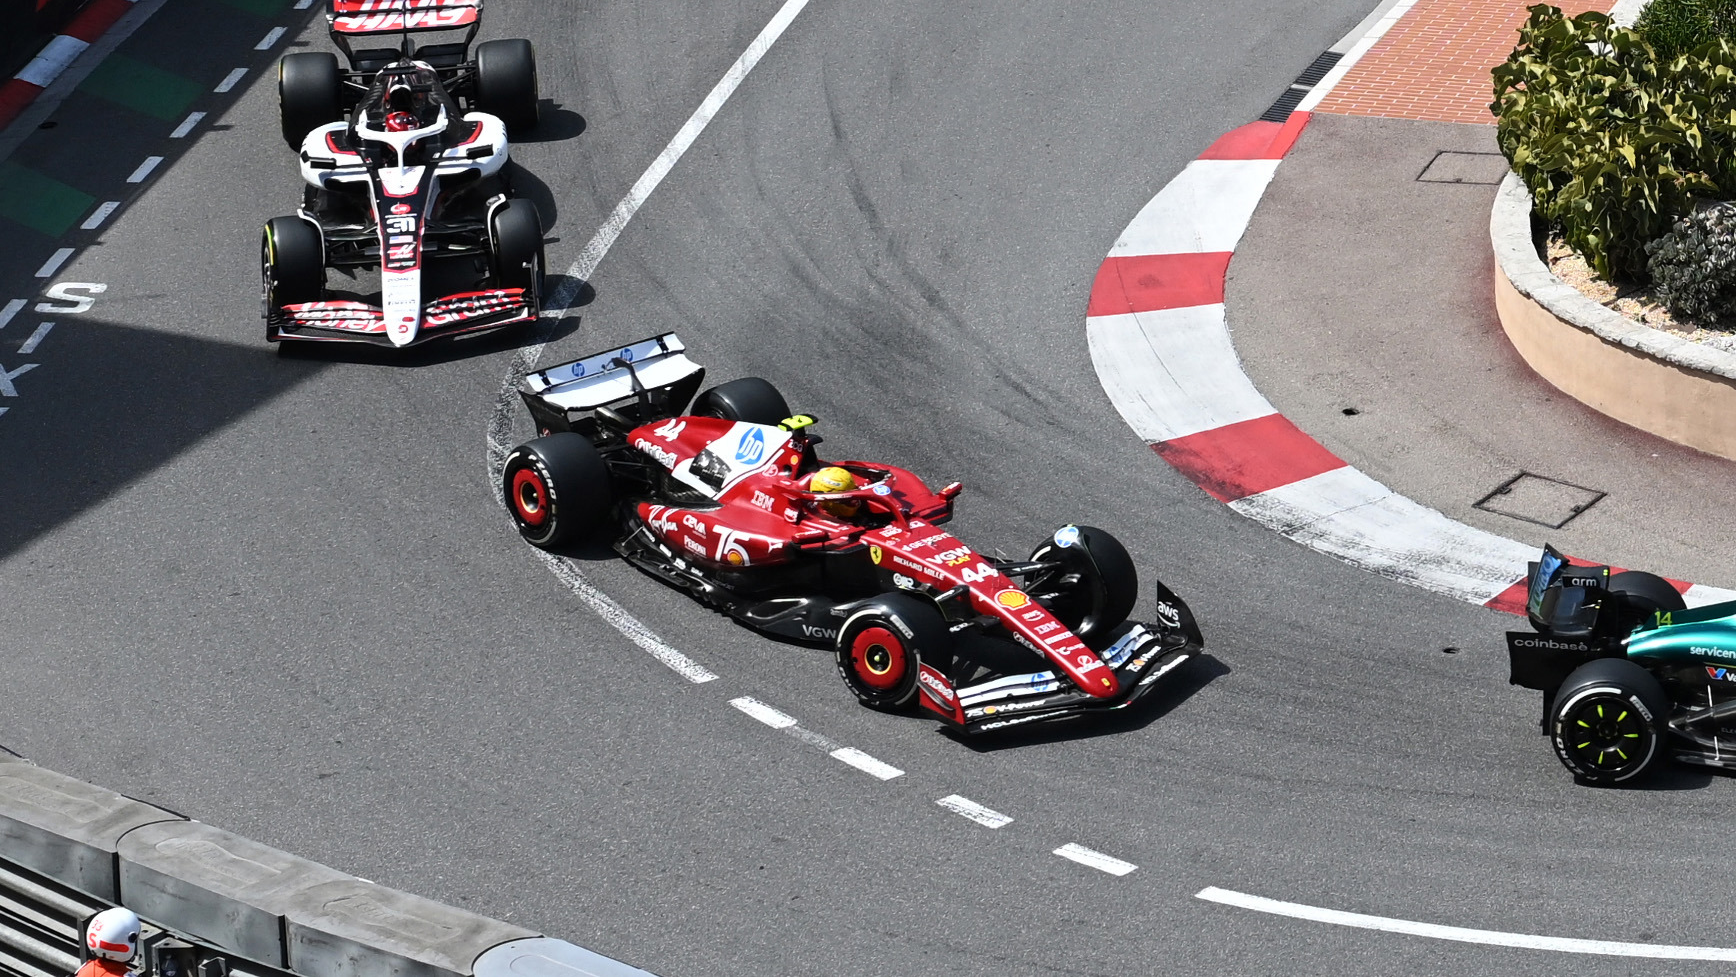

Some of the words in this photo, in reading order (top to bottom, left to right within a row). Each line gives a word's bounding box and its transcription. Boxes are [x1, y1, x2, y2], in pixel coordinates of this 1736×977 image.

[653, 418, 687, 442] 44
[735, 426, 765, 465] hp
[751, 490, 776, 512] IBM
[925, 545, 972, 565] VGW
[960, 562, 1000, 583] 44
[1571, 575, 1597, 587] arm
[1157, 601, 1180, 621] aws
[1654, 610, 1673, 626] 14
[802, 624, 836, 639] VGW
[1514, 638, 1589, 652] coinbase
